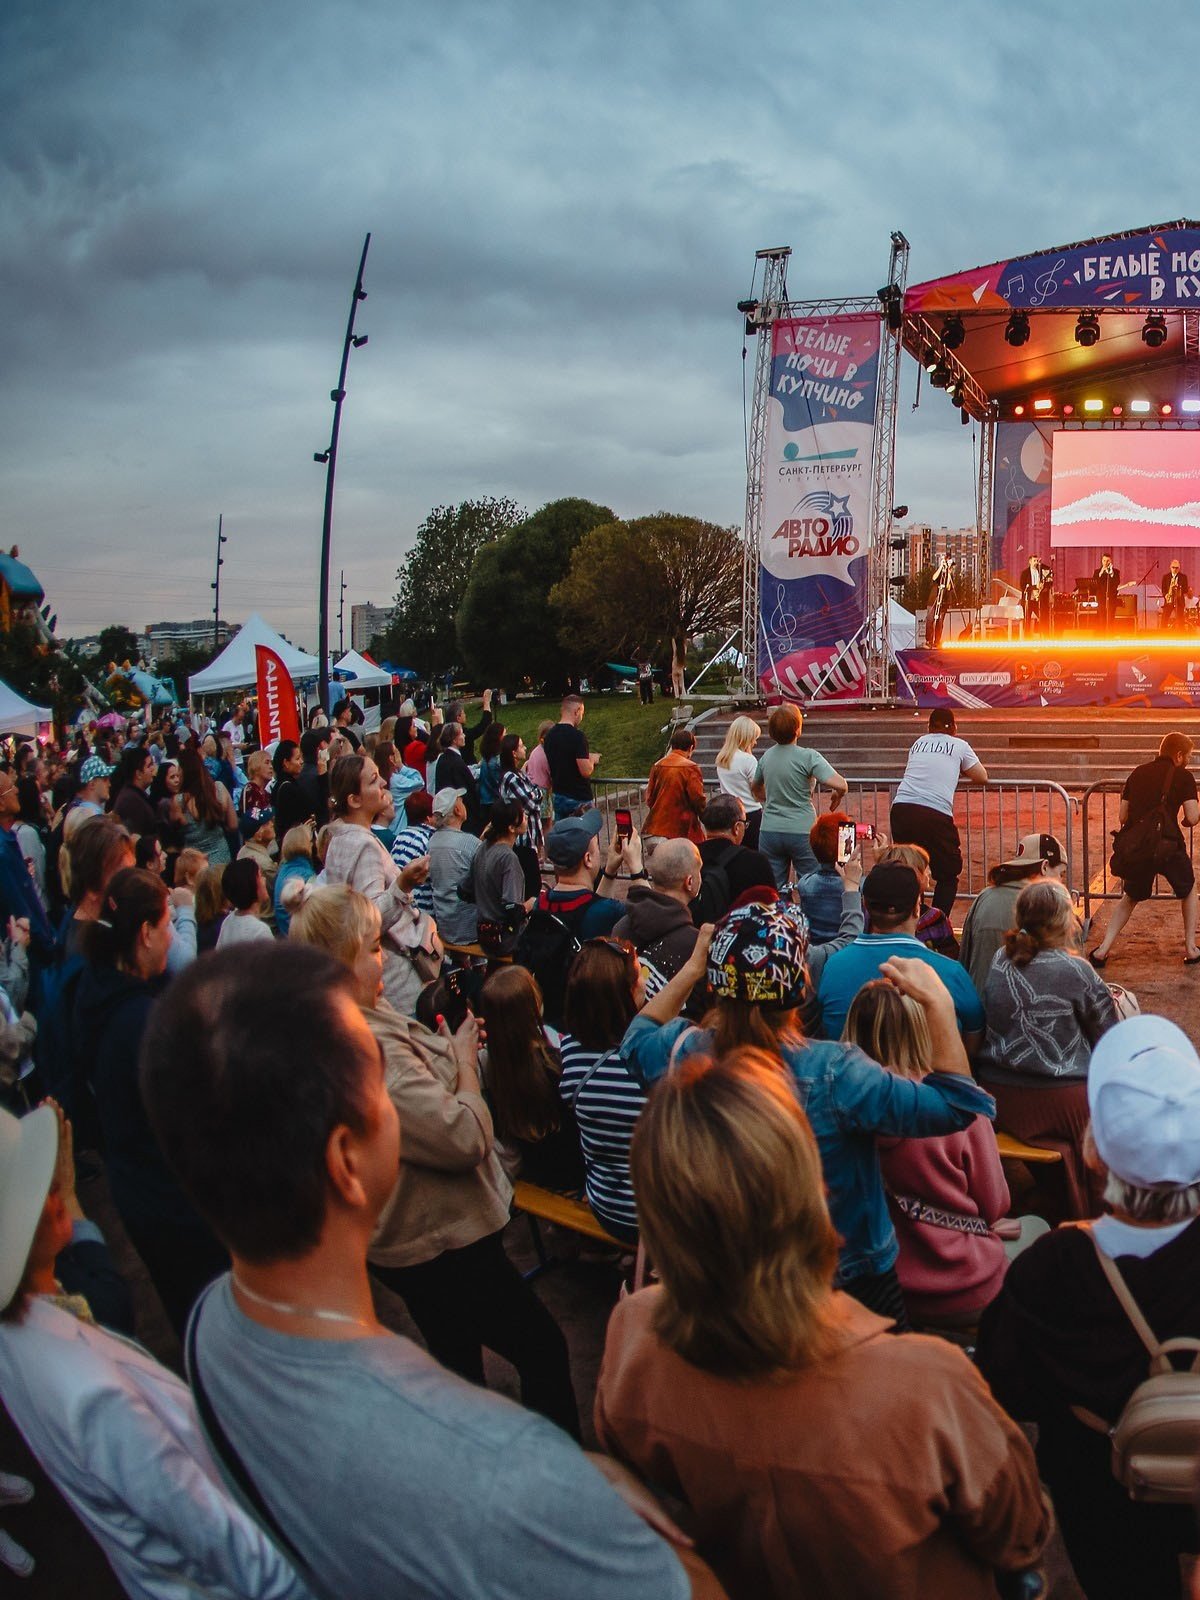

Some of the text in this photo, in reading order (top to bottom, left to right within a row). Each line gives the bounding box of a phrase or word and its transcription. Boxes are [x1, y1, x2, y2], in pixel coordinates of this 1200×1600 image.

[1083, 252, 1161, 282] БЕЛЫЕ
[1150, 277, 1166, 300] В
[795, 326, 852, 356] БЕЛЫЕ
[785, 351, 858, 381] НОЧИ В
[776, 374, 865, 409] КУПЧИНО
[771, 517, 829, 540] АВТО
[788, 536, 860, 558] РАДИО
